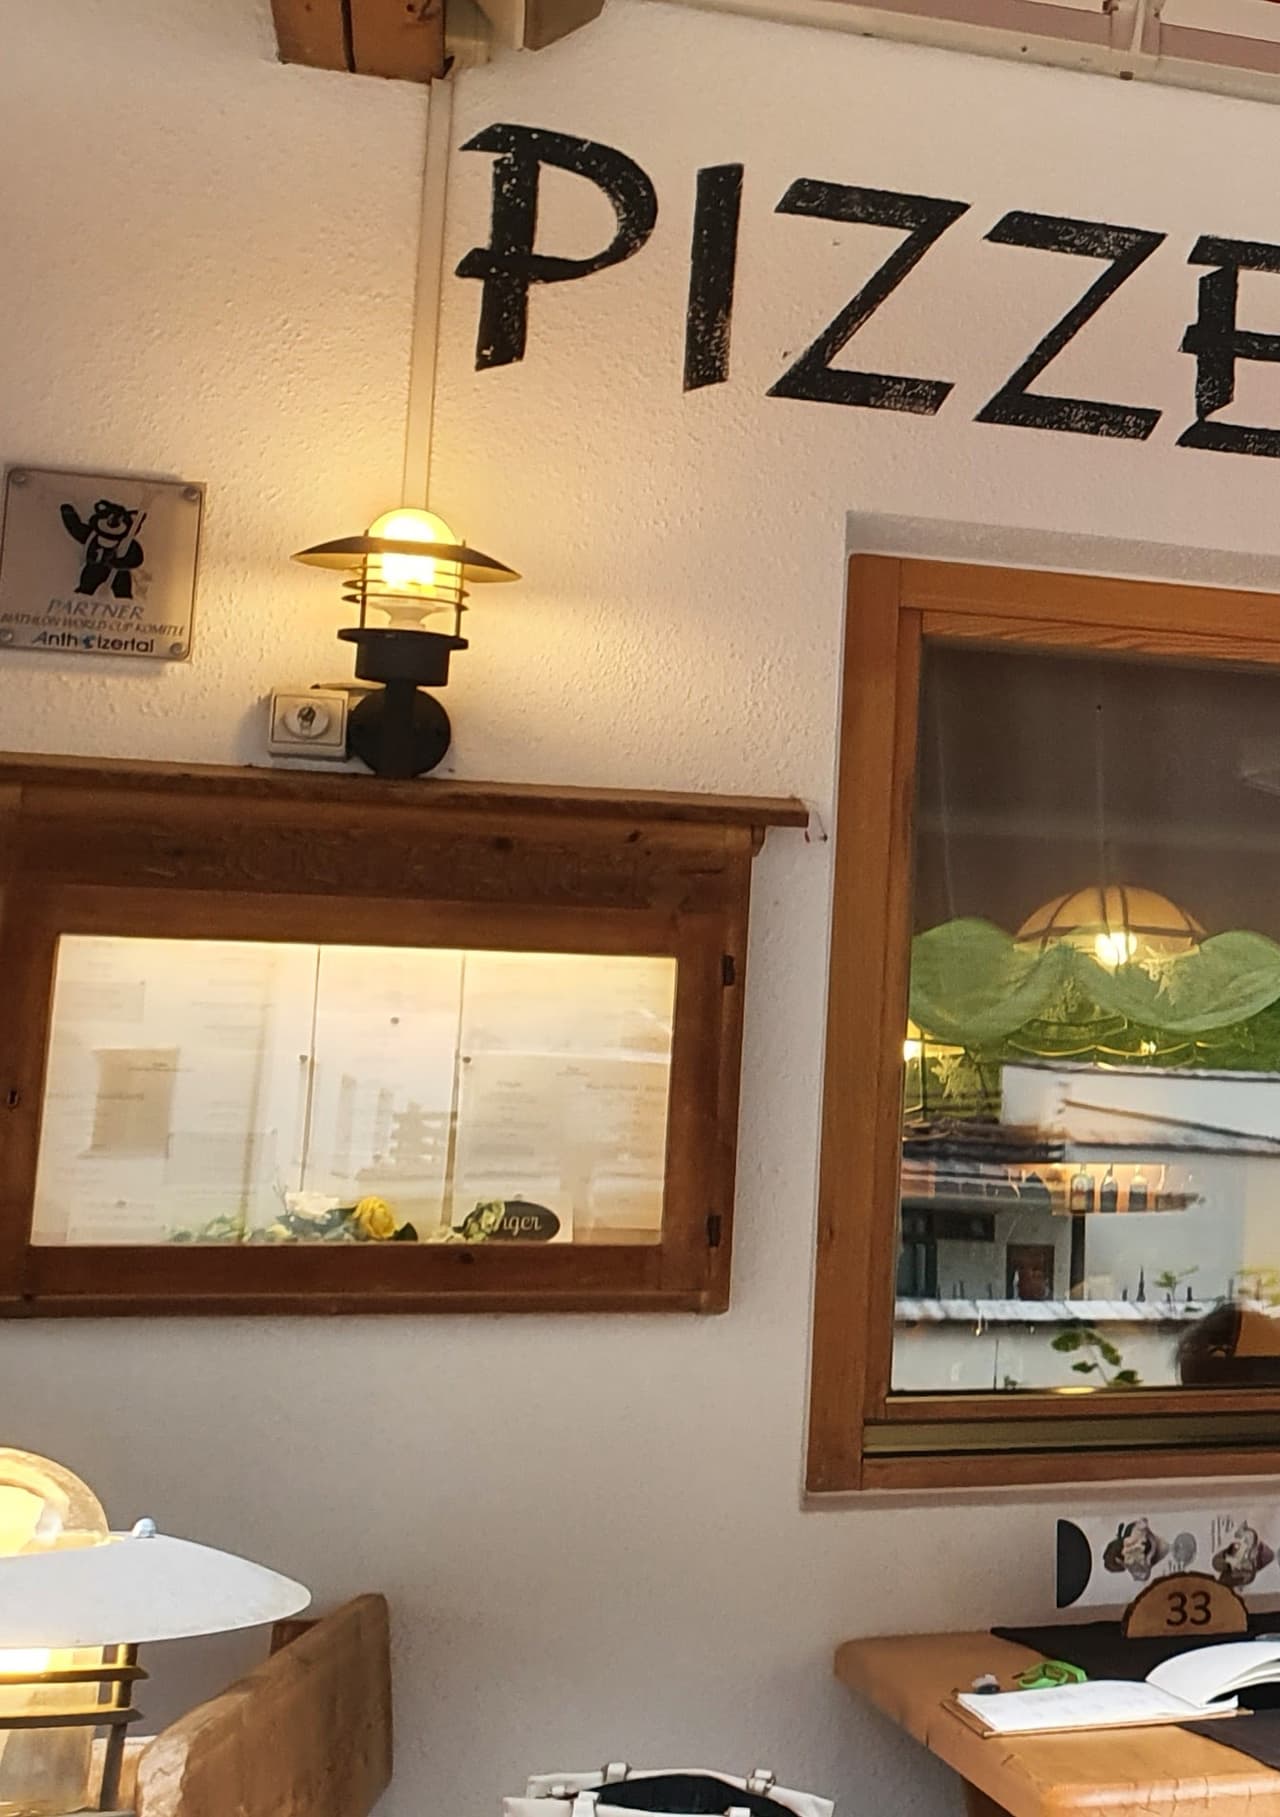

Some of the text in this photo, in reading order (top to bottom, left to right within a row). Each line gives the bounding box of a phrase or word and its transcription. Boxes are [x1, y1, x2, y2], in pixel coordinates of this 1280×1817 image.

[47, 599, 145, 621] PARTNER
[501, 1215, 543, 1236] nger
[1166, 1591, 1212, 1626] 33
